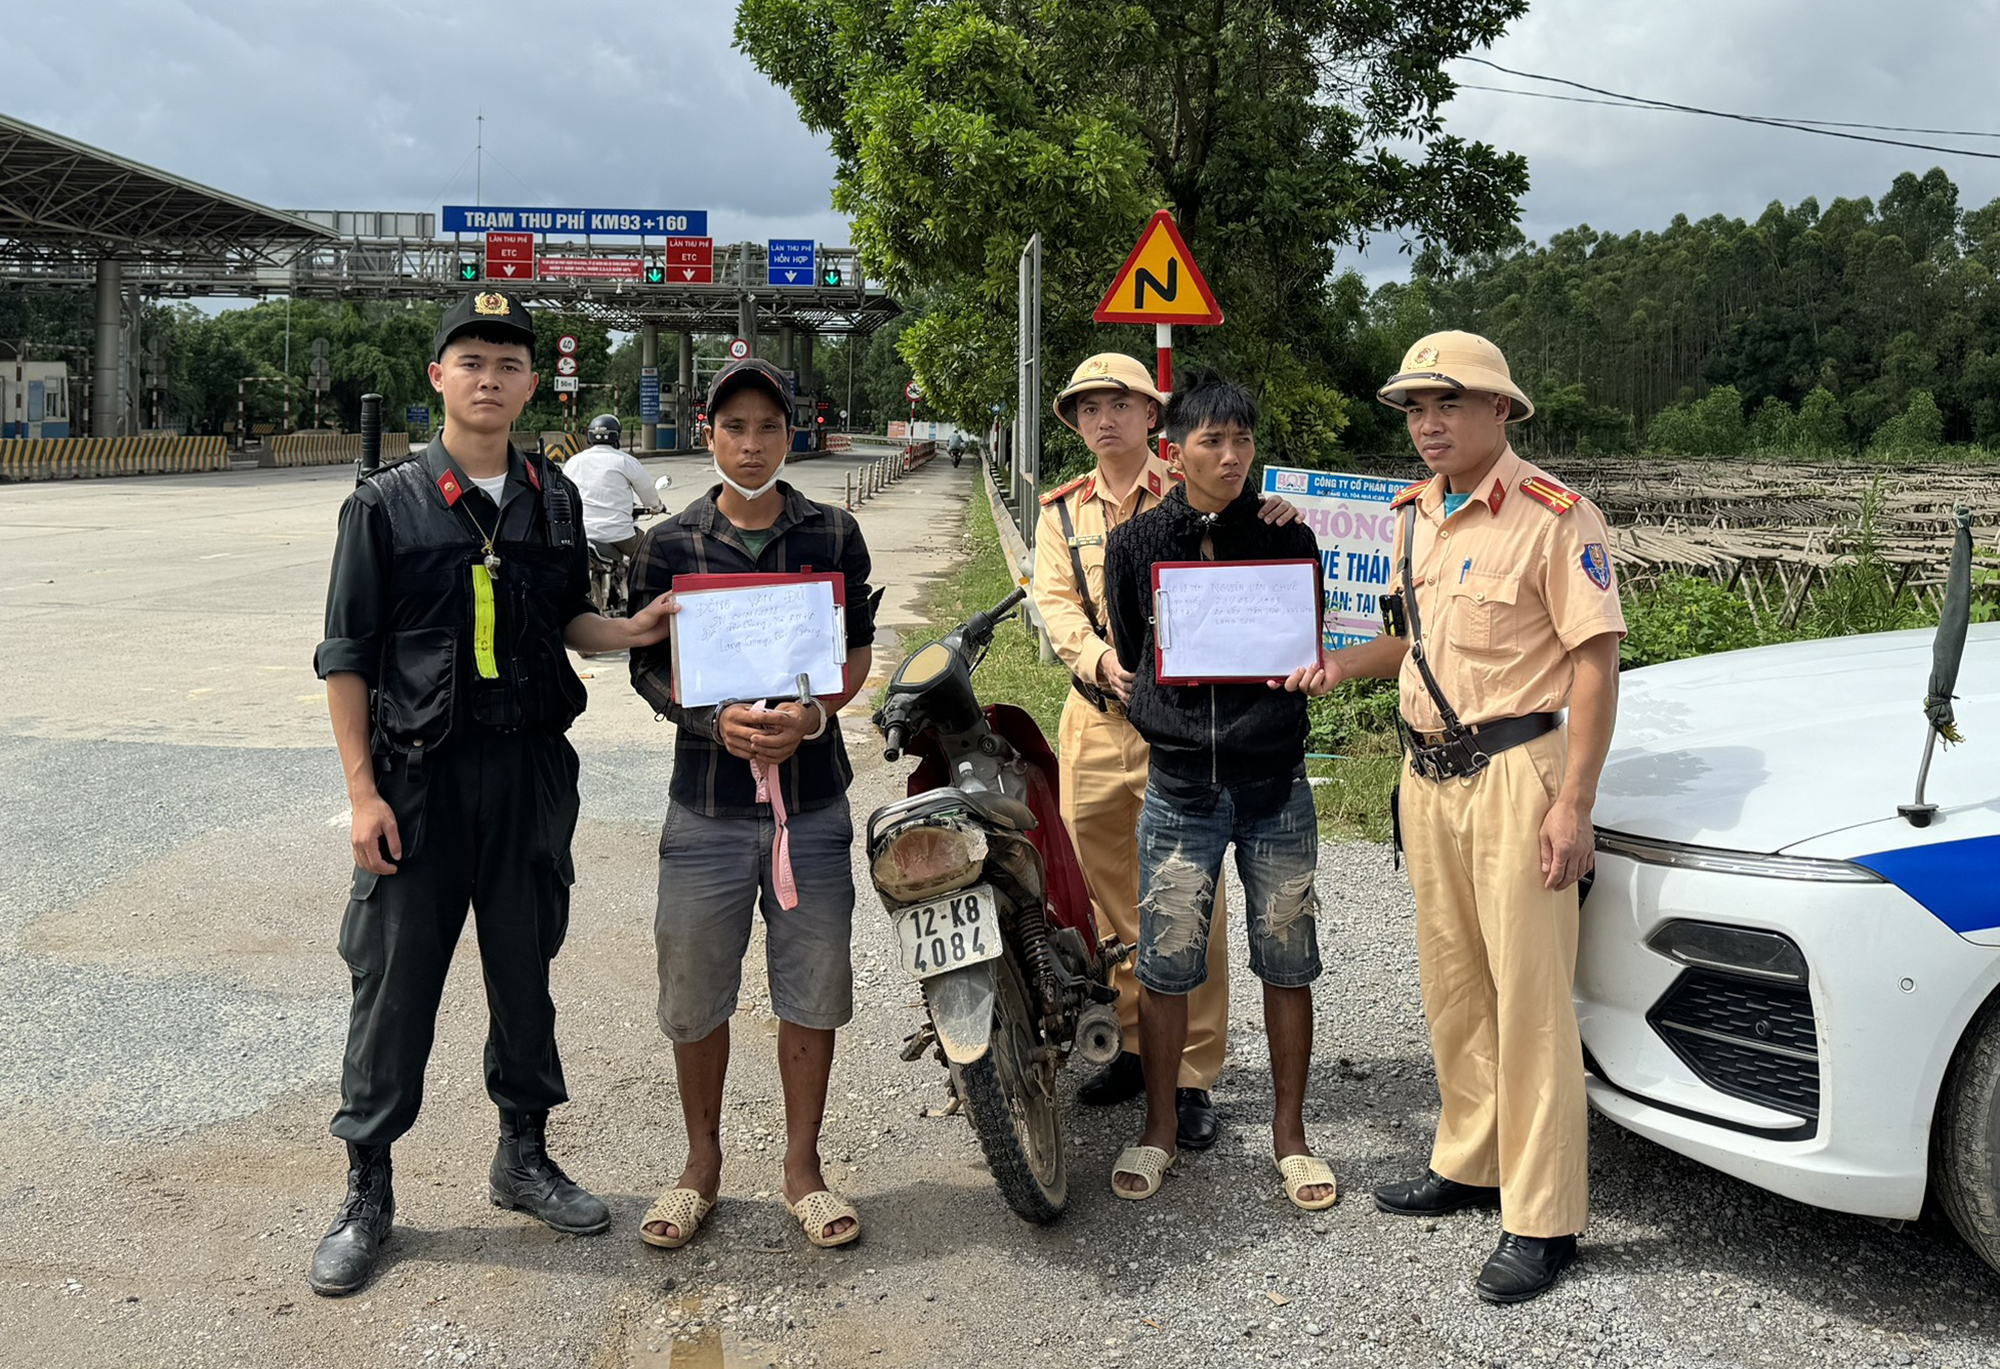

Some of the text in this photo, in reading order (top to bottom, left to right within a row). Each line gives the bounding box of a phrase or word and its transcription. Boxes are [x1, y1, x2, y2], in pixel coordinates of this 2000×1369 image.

[464, 211, 514, 231] TRẠM
[519, 213, 553, 229] THU
[556, 210, 586, 230] PHÍ
[503, 235, 517, 243] THU
[684, 240, 698, 248] THU
[786, 244, 800, 252] THU
[801, 243, 812, 252] PHÍ
[501, 249, 518, 258] ETC
[681, 253, 698, 262] ETC
[562, 340, 573, 350] 40
[734, 344, 745, 355] 40
[1314, 476, 1337, 488] CÔNG
[1338, 479, 1350, 490] TY
[1356, 593, 1376, 618] TẠI
[910, 895, 980, 939] 12-K8
[914, 926, 985, 972] 4084
